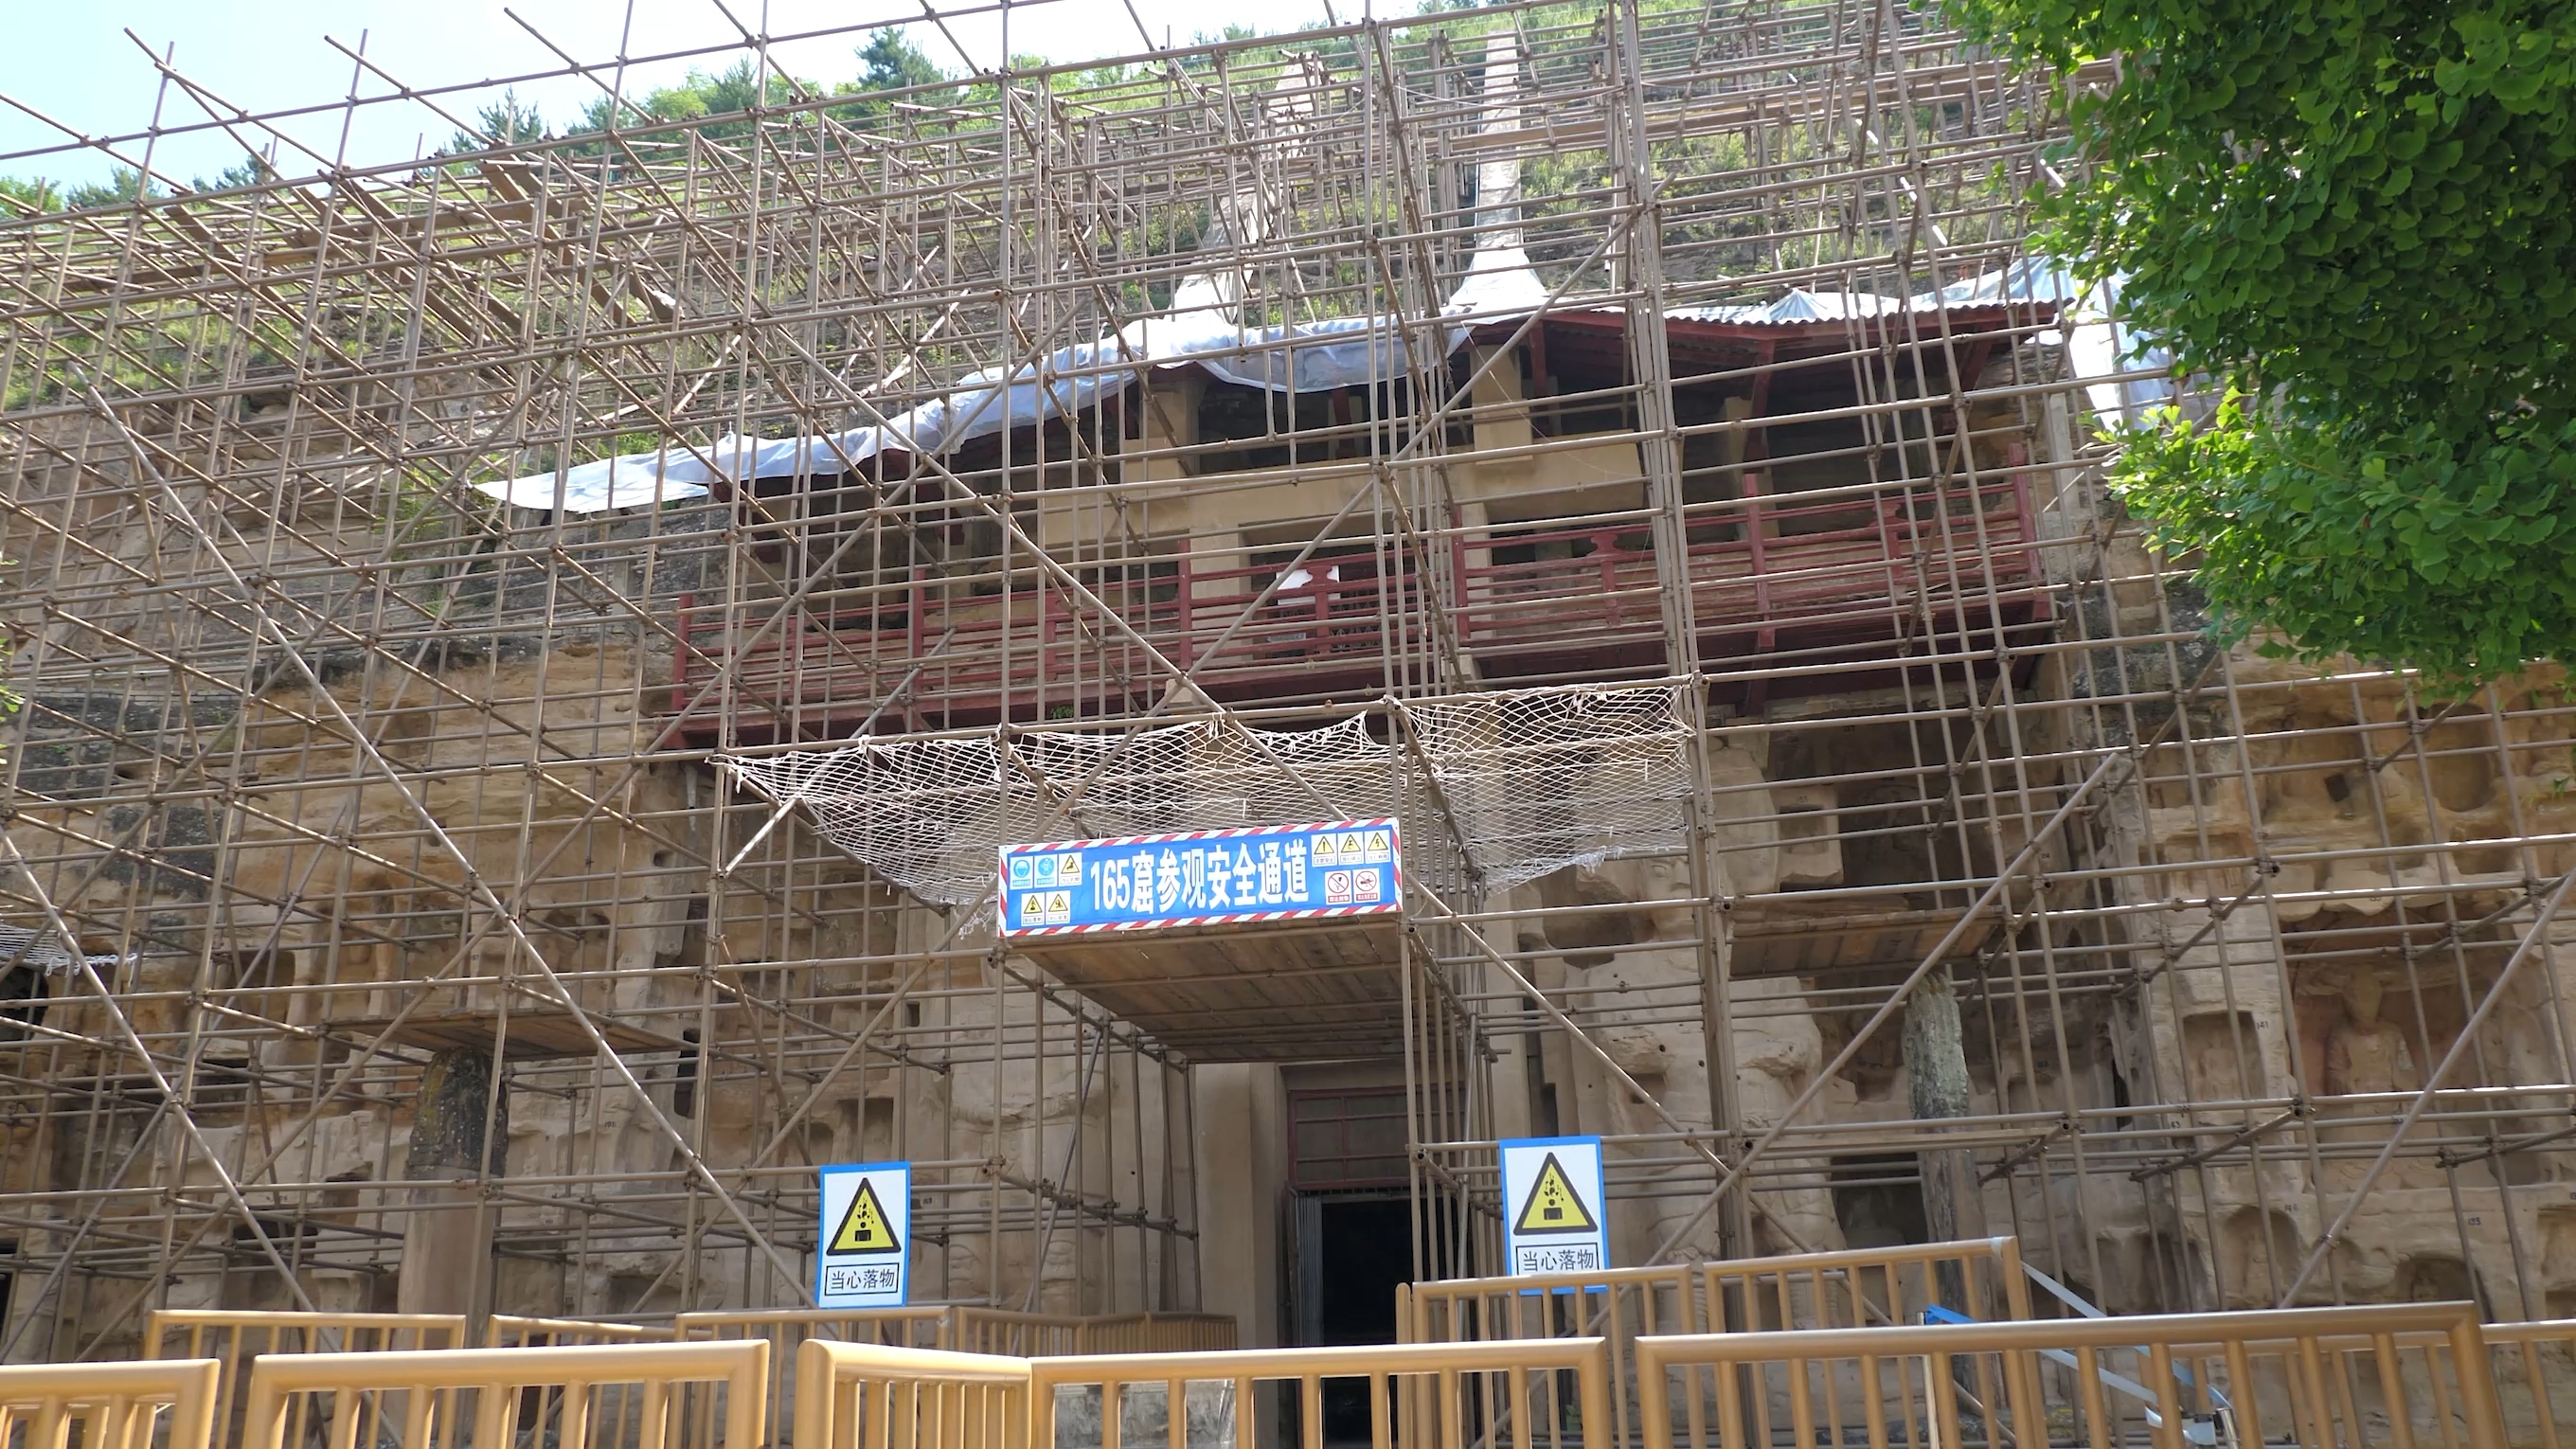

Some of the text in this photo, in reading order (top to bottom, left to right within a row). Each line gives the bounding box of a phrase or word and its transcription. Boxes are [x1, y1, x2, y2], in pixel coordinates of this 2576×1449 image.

[1090, 837, 1309, 914] 165窟参观安全通道
[2257, 1021, 2269, 1030] 141
[1523, 1248, 1594, 1272] 当心落物
[831, 1268, 895, 1290] 当心落物
